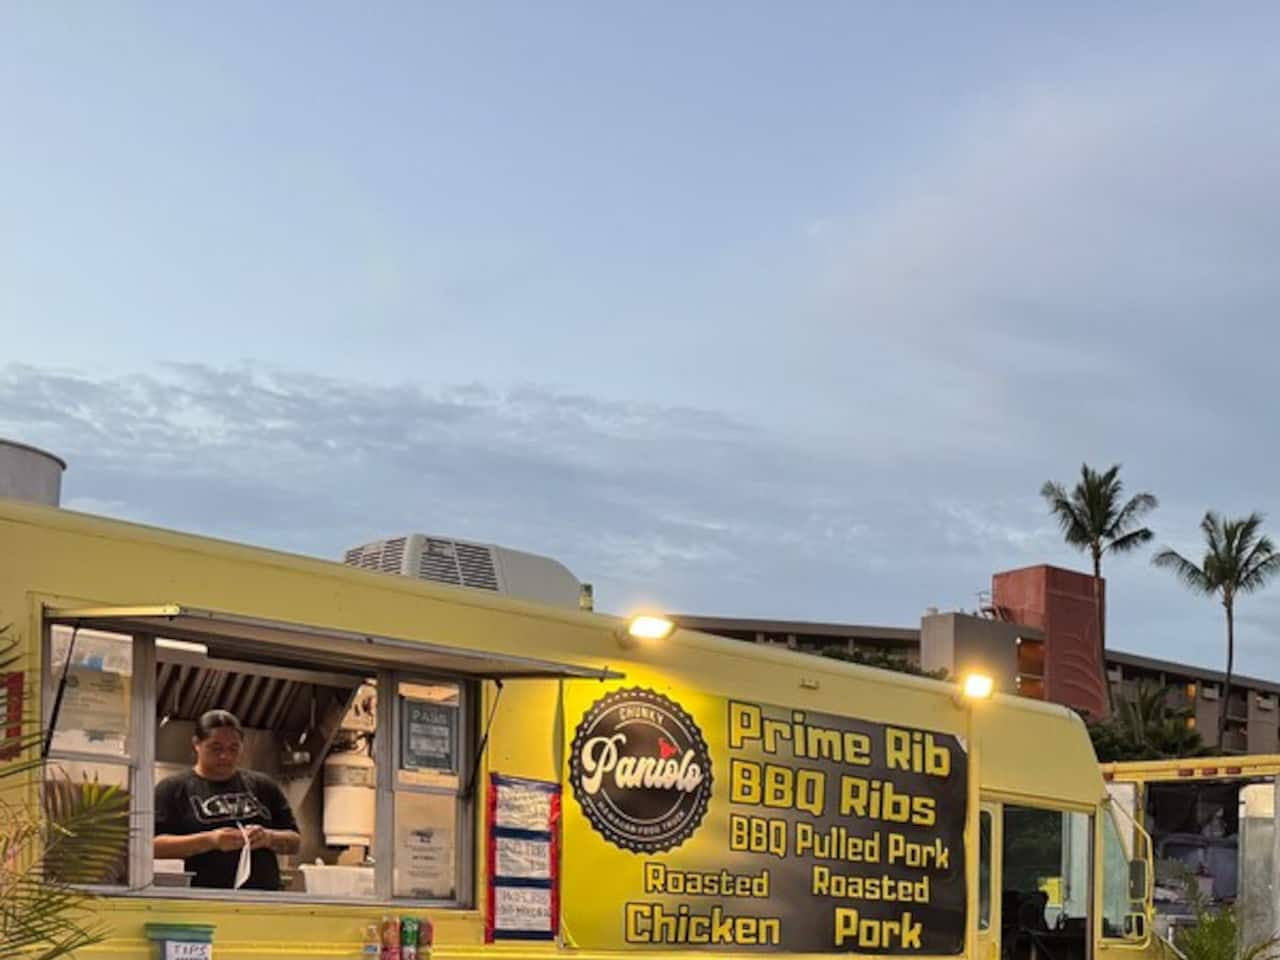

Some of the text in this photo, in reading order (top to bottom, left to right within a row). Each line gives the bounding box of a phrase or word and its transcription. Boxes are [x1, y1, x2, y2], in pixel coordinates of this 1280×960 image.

[619, 706, 665, 724] CHUNKY
[728, 699, 952, 777] Prime Rib
[581, 733, 704, 794] Paniolo
[730, 759, 938, 827] BBQ Ribs
[729, 815, 951, 869] BBQ Pulled Pork
[644, 862, 770, 898] Roasted
[812, 865, 931, 903] Roasted
[625, 902, 781, 946] Chicken
[834, 907, 923, 949] Pork
